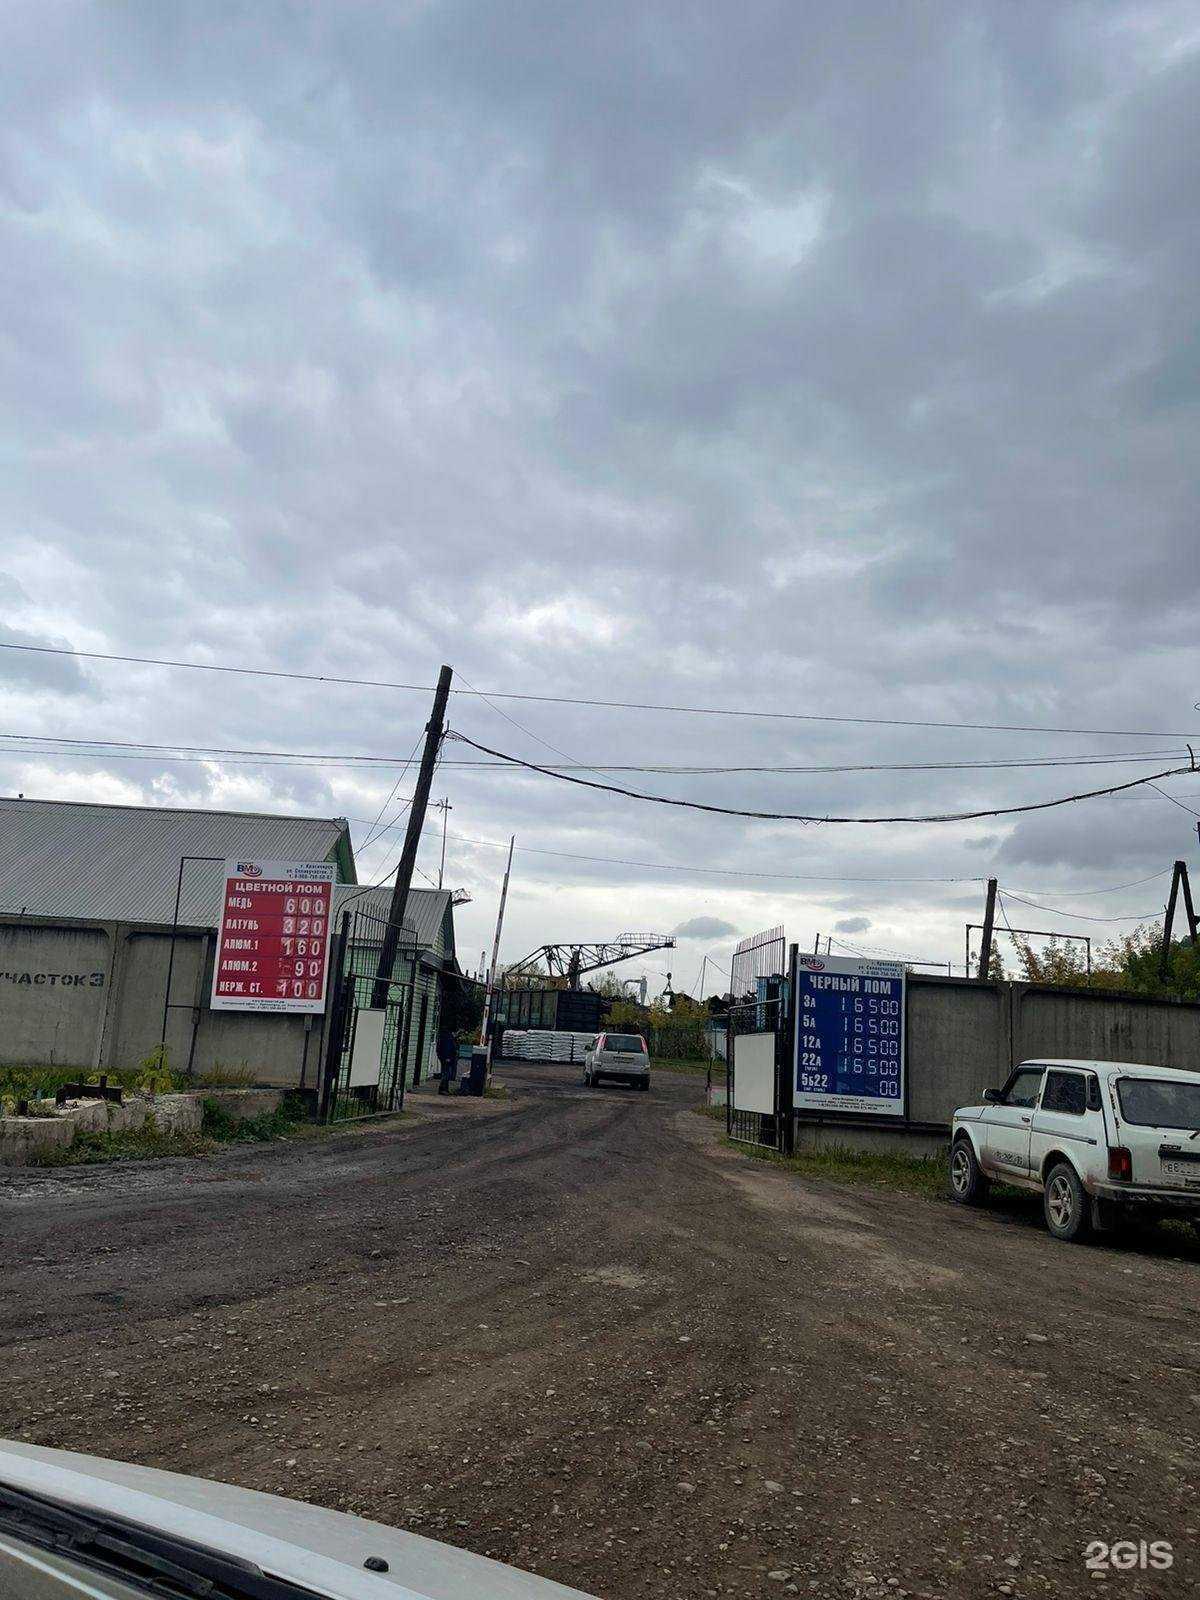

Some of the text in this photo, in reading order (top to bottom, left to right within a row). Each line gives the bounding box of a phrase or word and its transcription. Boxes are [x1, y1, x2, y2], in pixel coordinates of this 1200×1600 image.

[235, 882, 323, 894] ЦВЕТНОЙ ЛОМ
[228, 897, 324, 914] МЕДЬ 600
[226, 918, 323, 934] ЛАТУНЬ 320
[284, 939, 320, 955] 160
[295, 961, 318, 977] 90
[219, 981, 247, 993] НЕРЖ.
[249, 982, 264, 993] СТ.
[809, 975, 891, 995] ЧЕРНЫЙ ЛОМ
[803, 1014, 816, 1028] 5А
[802, 1035, 821, 1049] 12А
[802, 1053, 821, 1067] 22А
